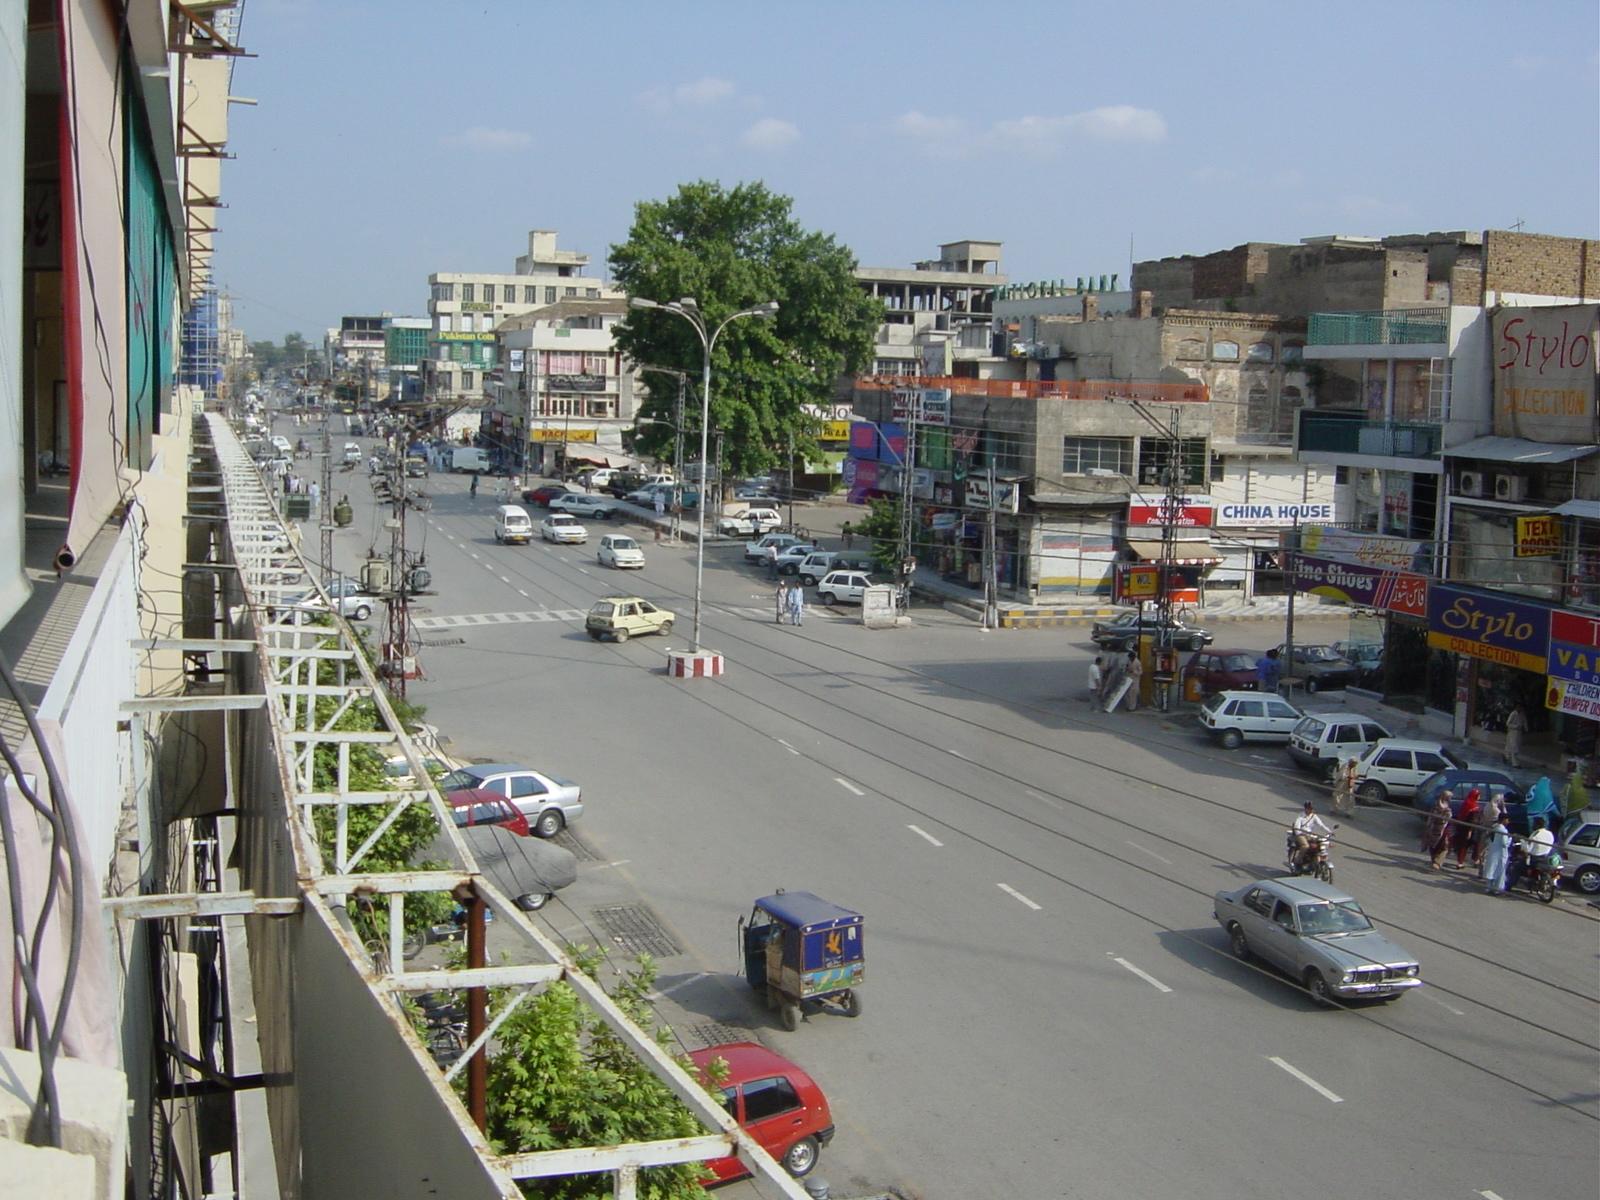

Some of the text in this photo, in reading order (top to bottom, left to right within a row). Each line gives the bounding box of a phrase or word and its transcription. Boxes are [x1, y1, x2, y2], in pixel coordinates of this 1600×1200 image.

[1077, 274, 1119, 294] BANK
[1499, 318, 1590, 374] Stylo
[1504, 388, 1585, 416] COLLECTION
[1223, 505, 1331, 519] CHINA HOUSE
[1524, 520, 1554, 536] TEXT
[1327, 563, 1374, 591] Shoes
[1441, 597, 1534, 643] Stylo
[1450, 638, 1521, 667] COLLECTION
